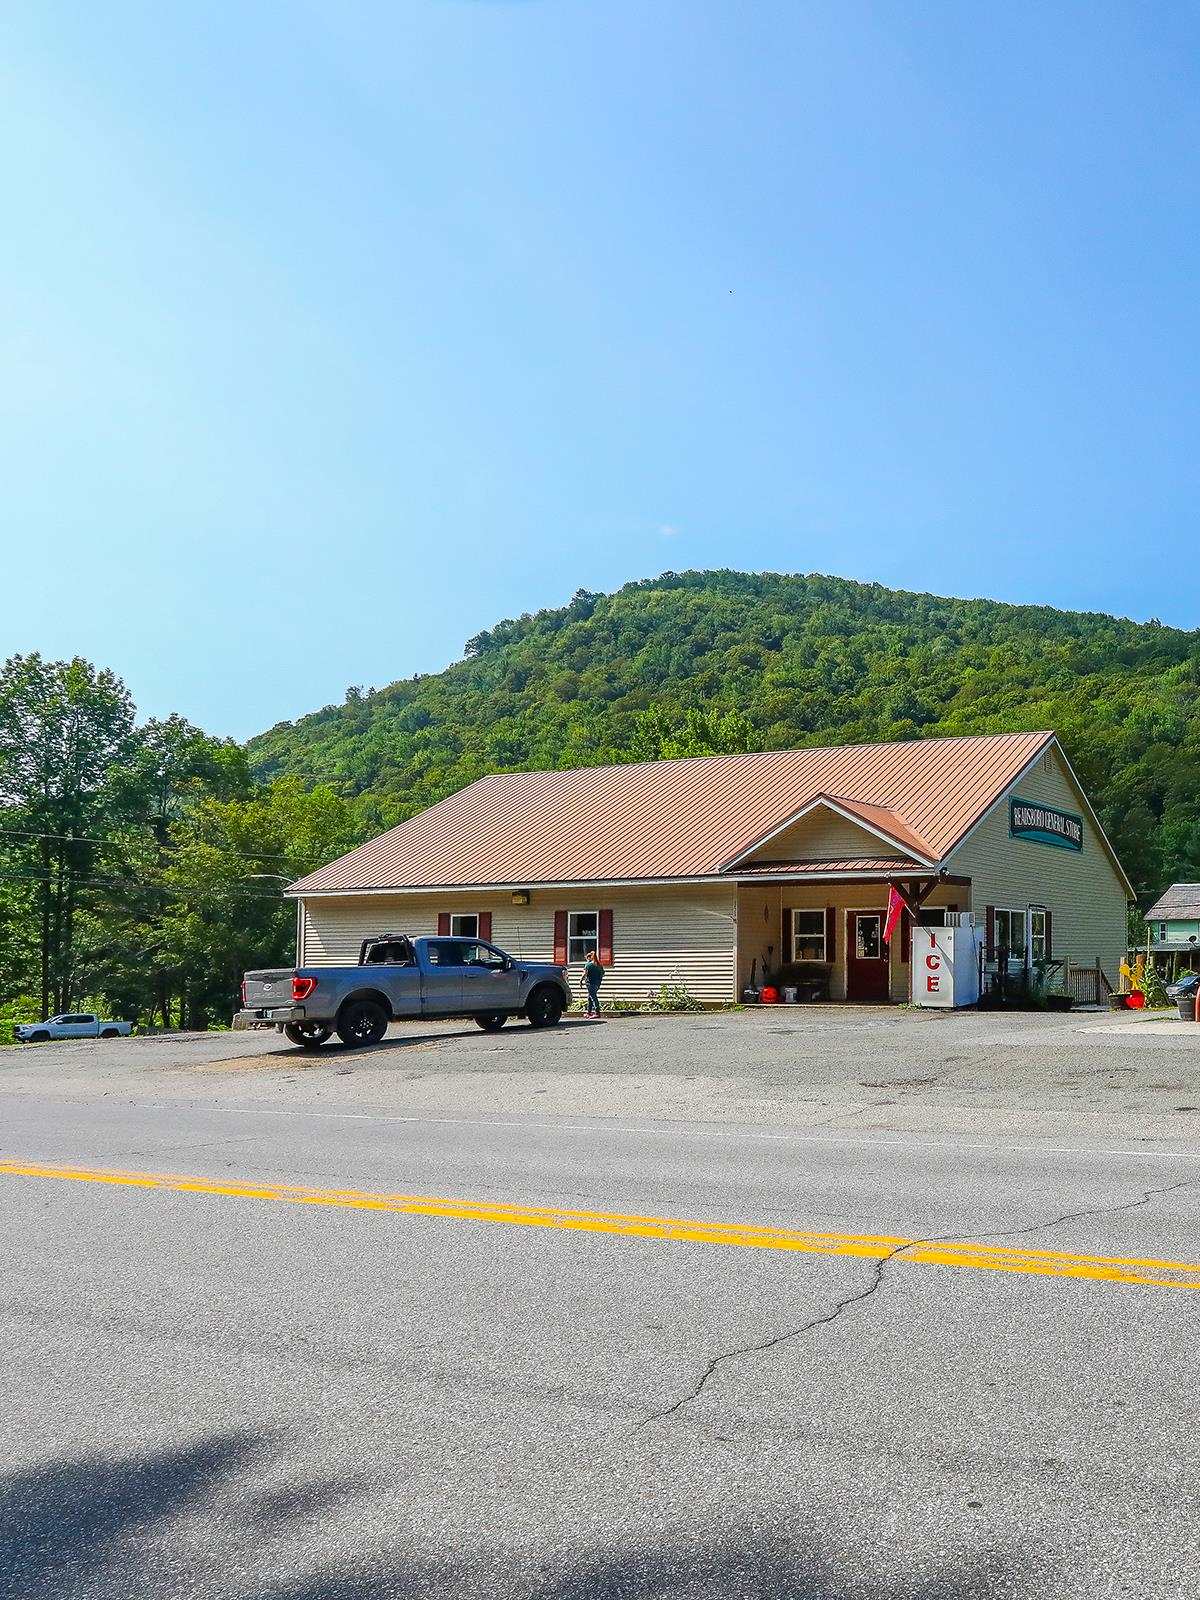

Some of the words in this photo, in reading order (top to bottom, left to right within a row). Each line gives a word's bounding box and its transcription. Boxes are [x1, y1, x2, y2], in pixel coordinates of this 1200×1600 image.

[1045, 811, 1066, 835] GENERAL
[1065, 819, 1081, 842] STORE
[925, 932, 941, 993] ICE
